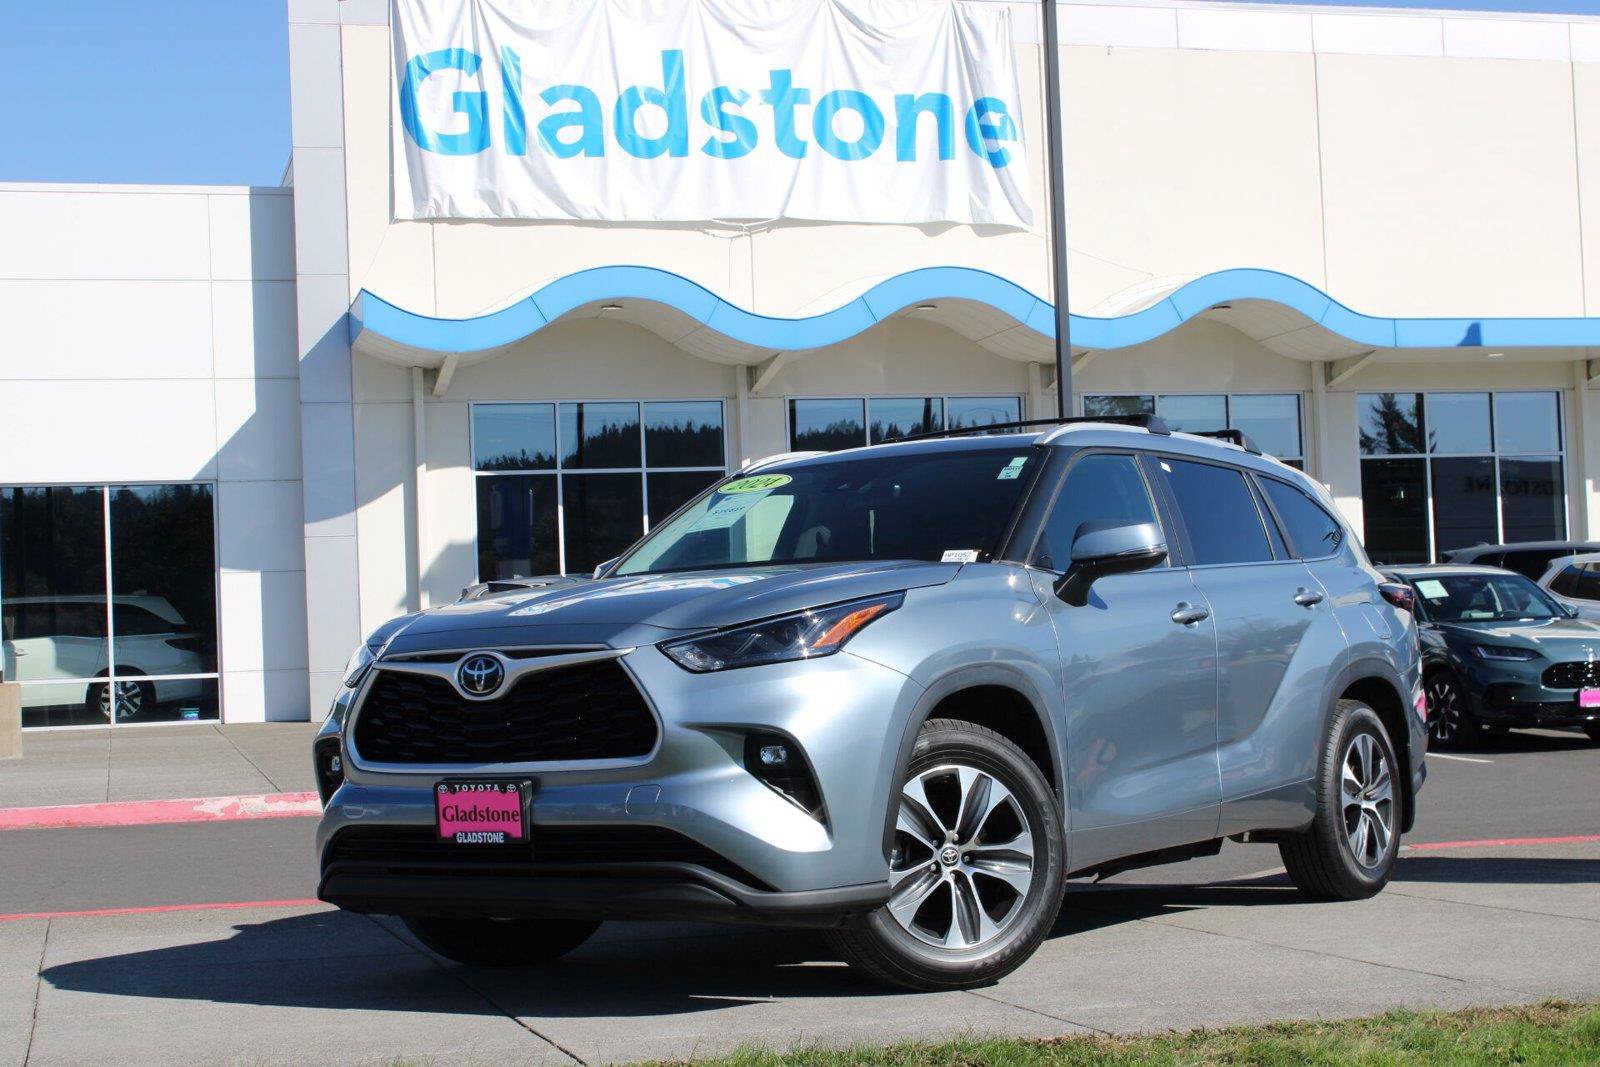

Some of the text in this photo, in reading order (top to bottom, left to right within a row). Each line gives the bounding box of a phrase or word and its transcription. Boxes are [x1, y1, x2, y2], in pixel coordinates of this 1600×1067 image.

[400, 48, 1018, 169] Gladstone
[454, 784, 500, 792] TOYOTA
[442, 804, 520, 823] Gladstone
[456, 832, 505, 844] GLADSTONE
